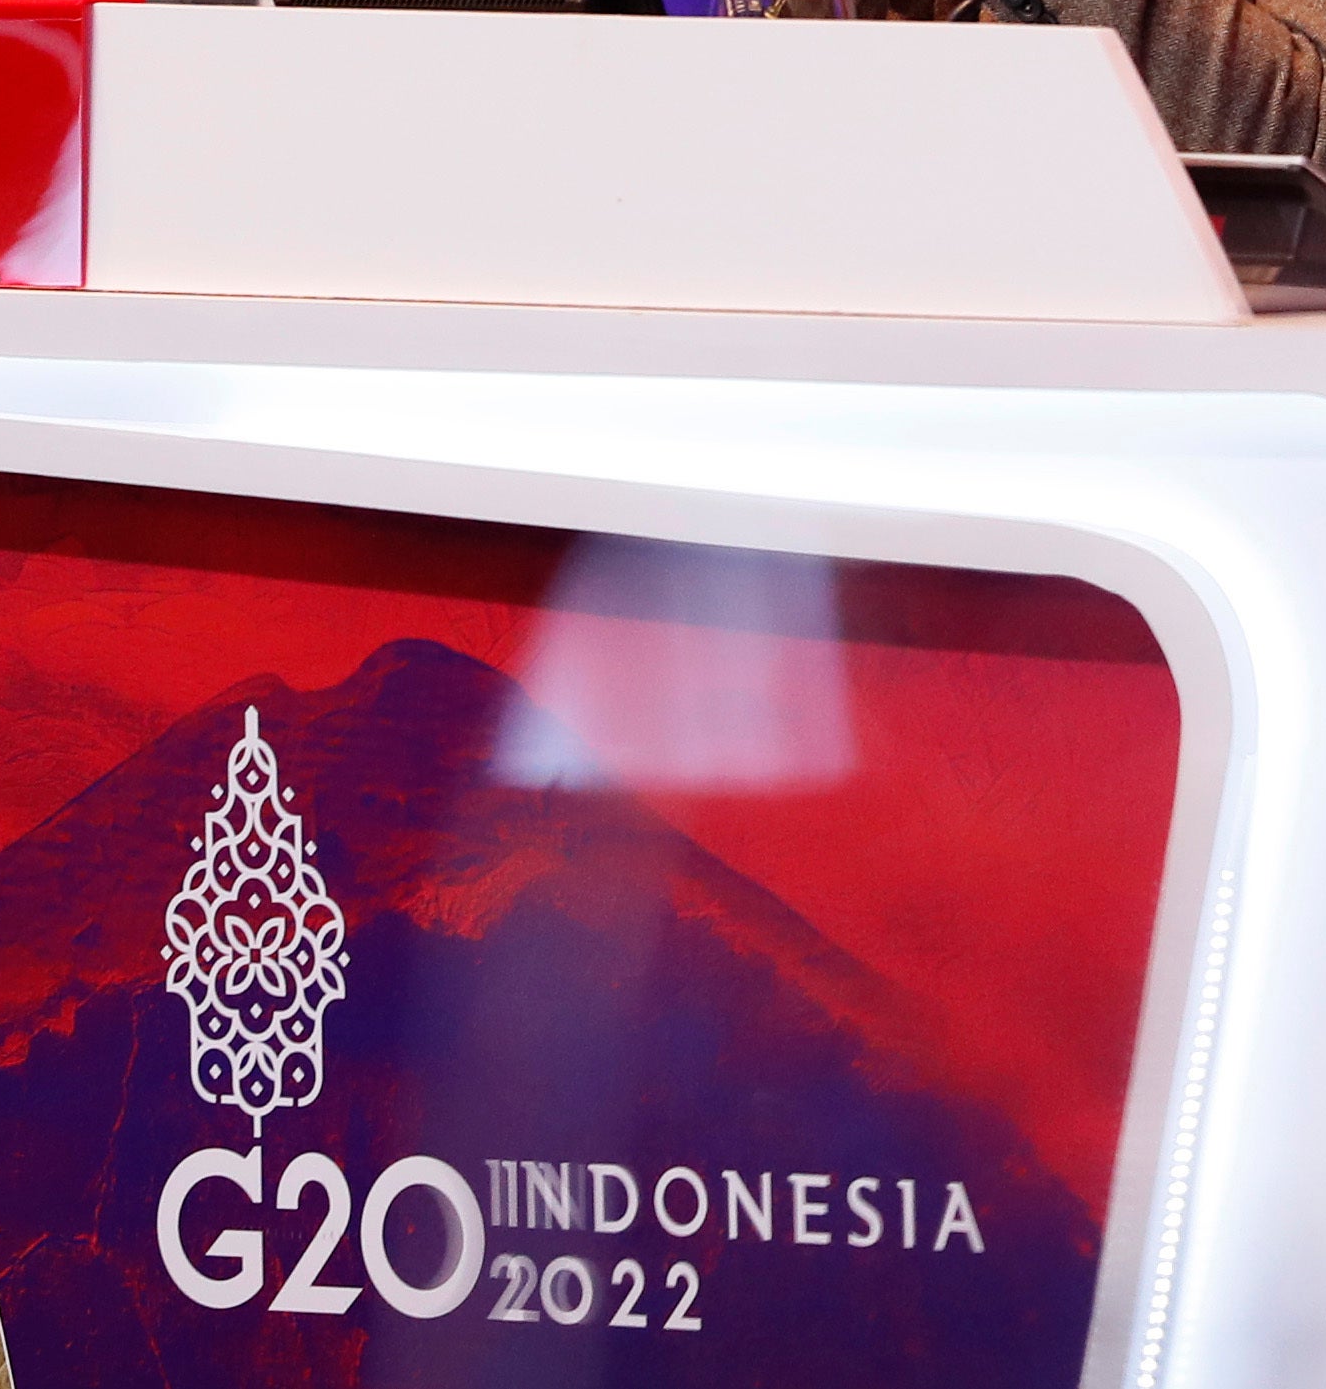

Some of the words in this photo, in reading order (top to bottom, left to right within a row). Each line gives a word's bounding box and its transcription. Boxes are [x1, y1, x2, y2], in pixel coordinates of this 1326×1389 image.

[156, 1145, 486, 1319] G20
[485, 1158, 986, 1254] INDONESIA
[486, 1253, 703, 1332] 2022
